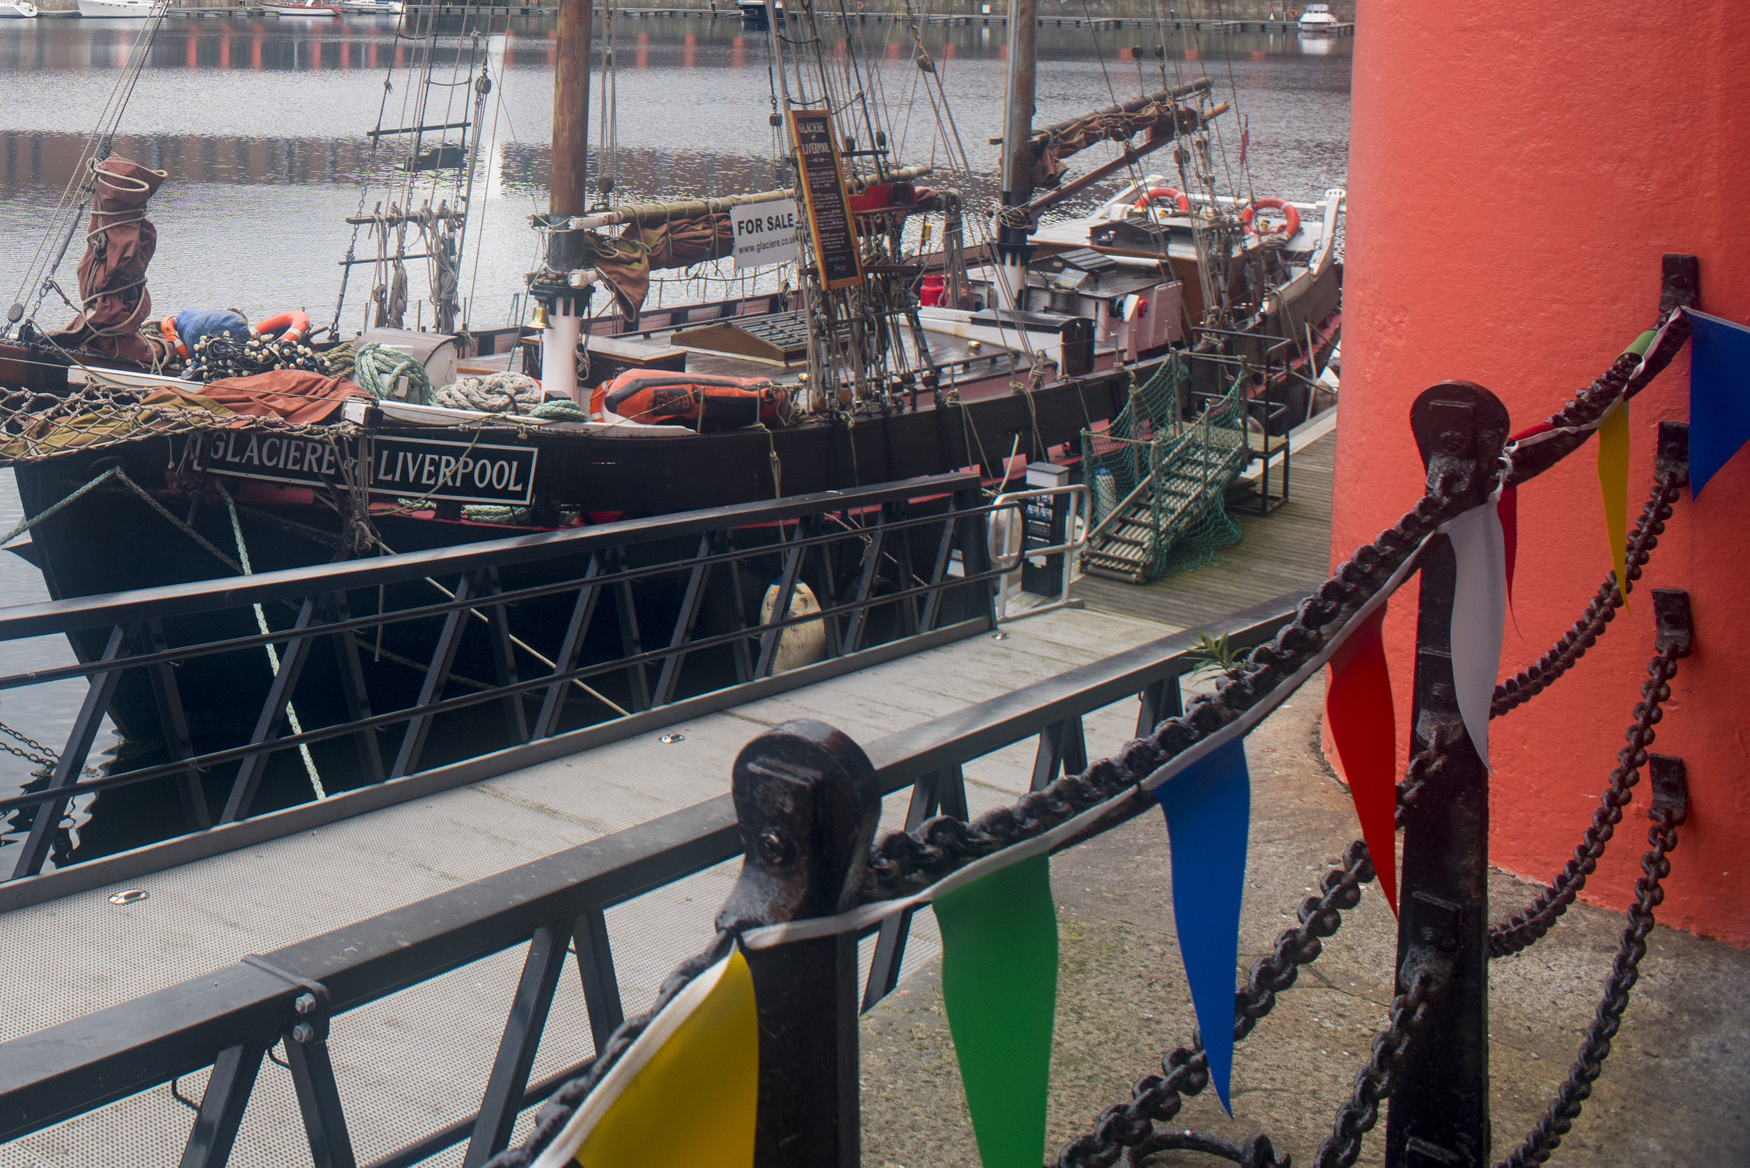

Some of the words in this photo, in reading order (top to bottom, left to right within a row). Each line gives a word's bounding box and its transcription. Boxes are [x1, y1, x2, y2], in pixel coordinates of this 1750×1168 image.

[799, 122, 826, 134] GLACIERE
[801, 142, 831, 155] LIVERPOOL
[737, 218, 764, 236] FOR
[766, 213, 794, 232] SALE
[738, 234, 799, 254] www.glaciere.co.uk
[209, 432, 339, 475] GLACIERE
[377, 450, 523, 492] LIVERPOOL
